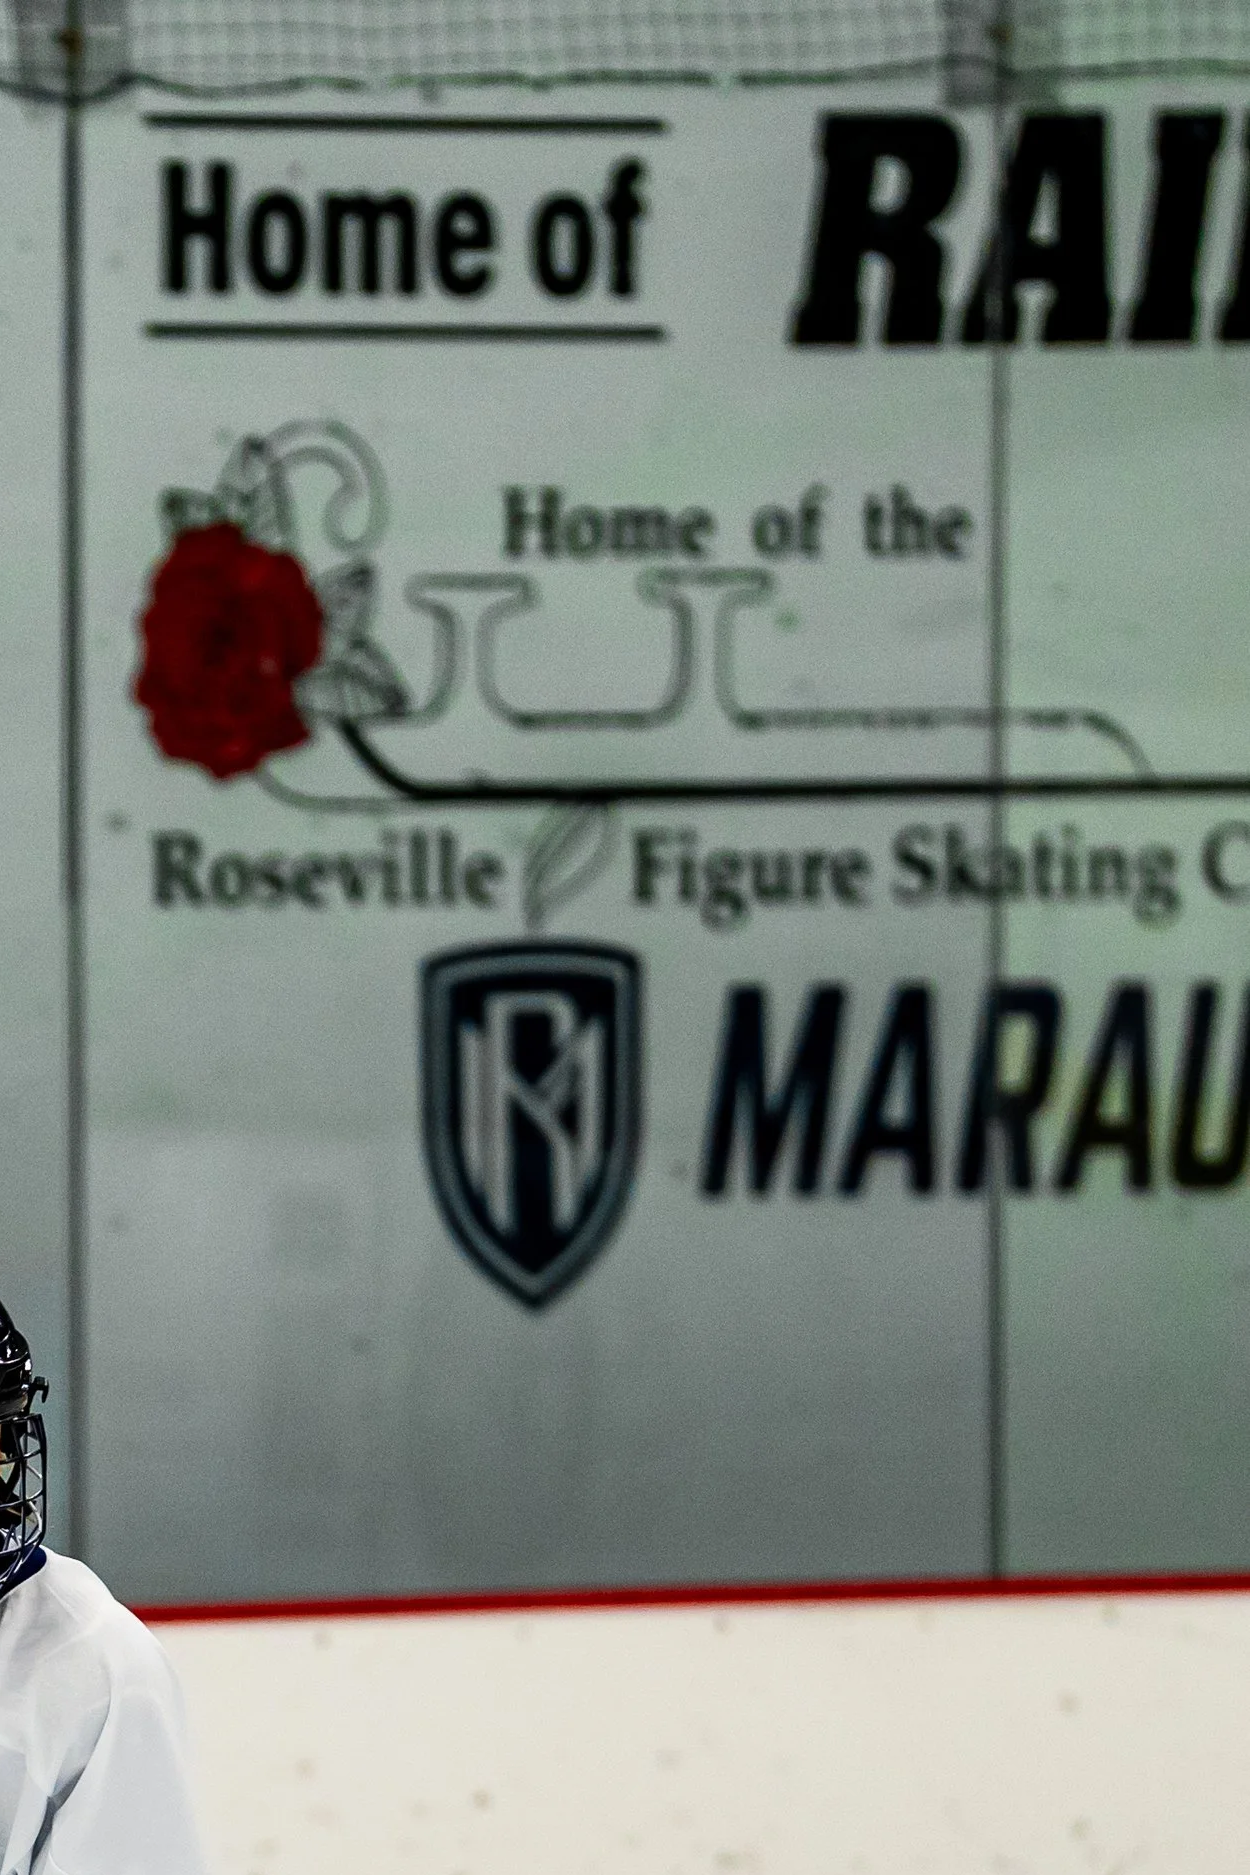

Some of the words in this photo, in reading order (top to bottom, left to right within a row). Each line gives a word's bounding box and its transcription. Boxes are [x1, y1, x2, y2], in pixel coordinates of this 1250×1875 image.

[161, 157, 497, 303] Home
[530, 156, 647, 303] of
[786, 108, 1250, 349] RAI
[503, 485, 716, 562] Home
[751, 483, 830, 560] of
[862, 485, 975, 563] the
[150, 828, 507, 911] Roseville
[630, 826, 874, 932] Figure
[890, 822, 1180, 930] Skating
